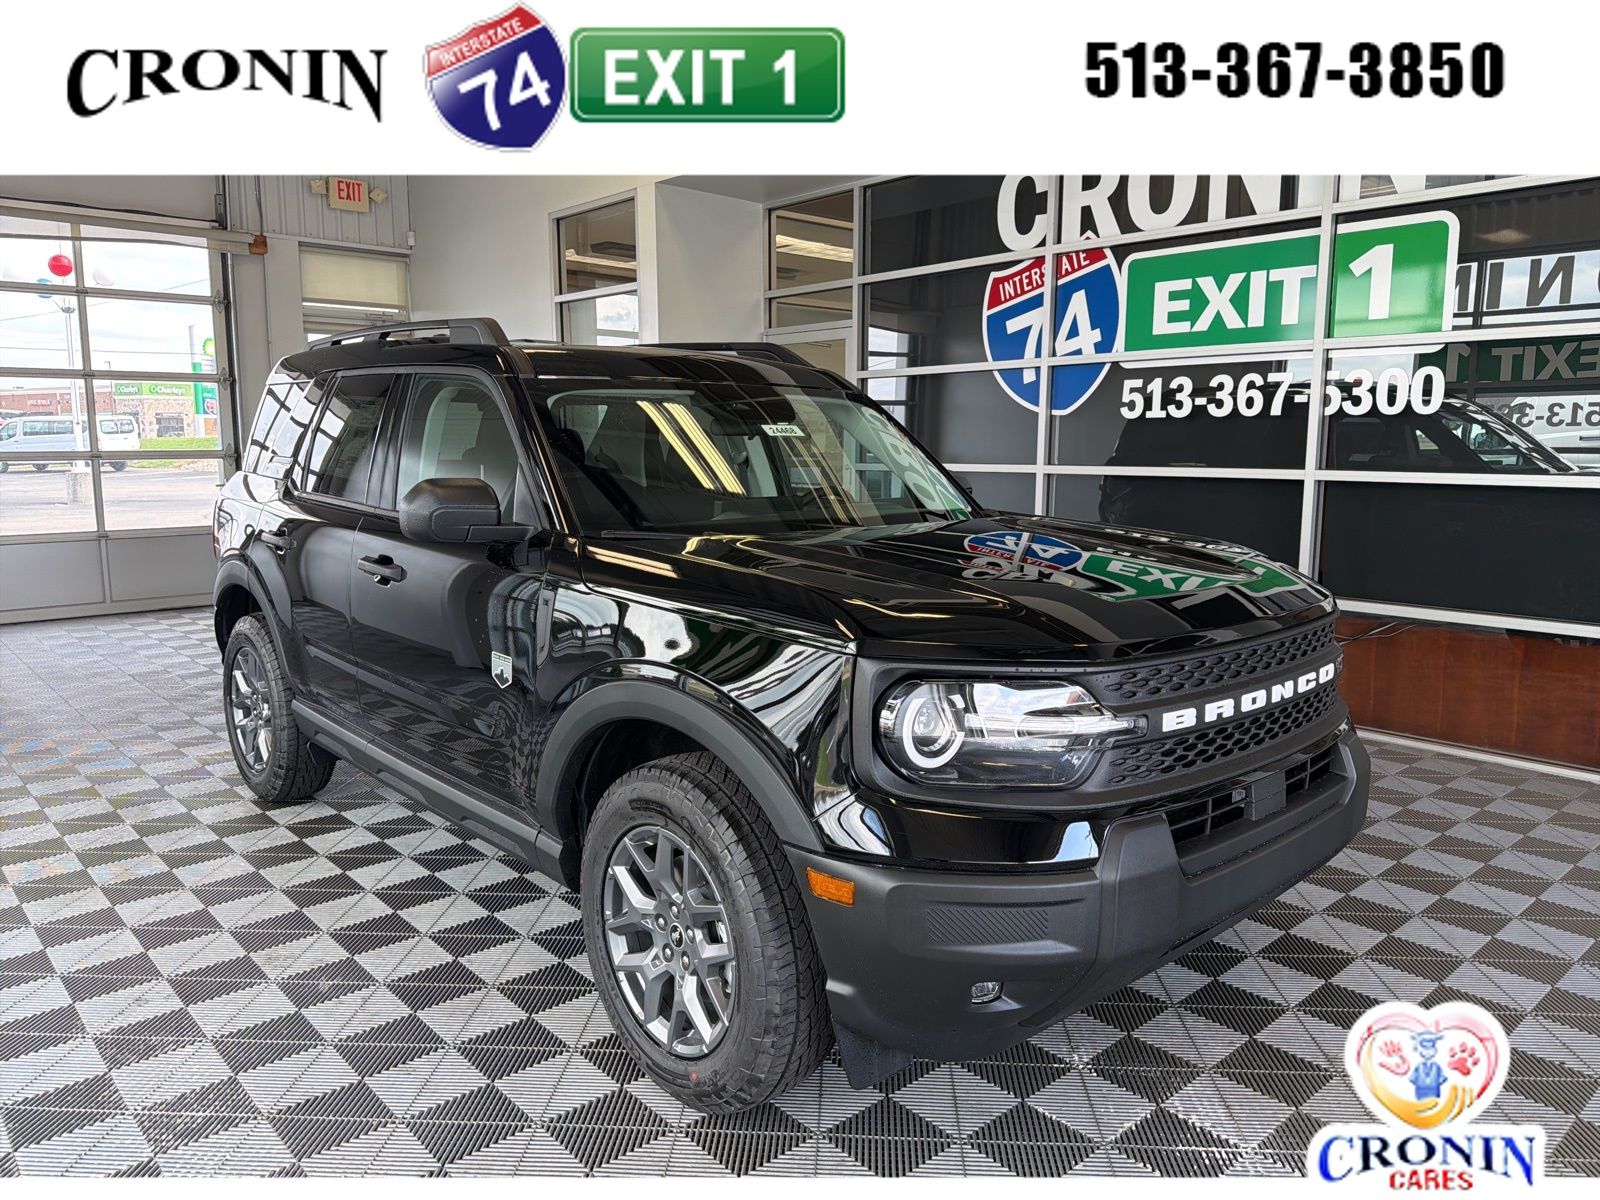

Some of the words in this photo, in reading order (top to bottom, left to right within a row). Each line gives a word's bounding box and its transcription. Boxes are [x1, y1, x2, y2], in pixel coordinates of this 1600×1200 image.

[337, 180, 362, 202] EXIT
[997, 174, 1428, 252] CRON
[999, 249, 1090, 302] INTERSATE
[1153, 265, 1317, 336] EXIT
[1348, 243, 1394, 320] 1
[1005, 288, 1102, 385] 74
[1119, 365, 1446, 419] 513-367-5300
[768, 426, 798, 435] 24468
[1163, 663, 1335, 733] BRONCO
